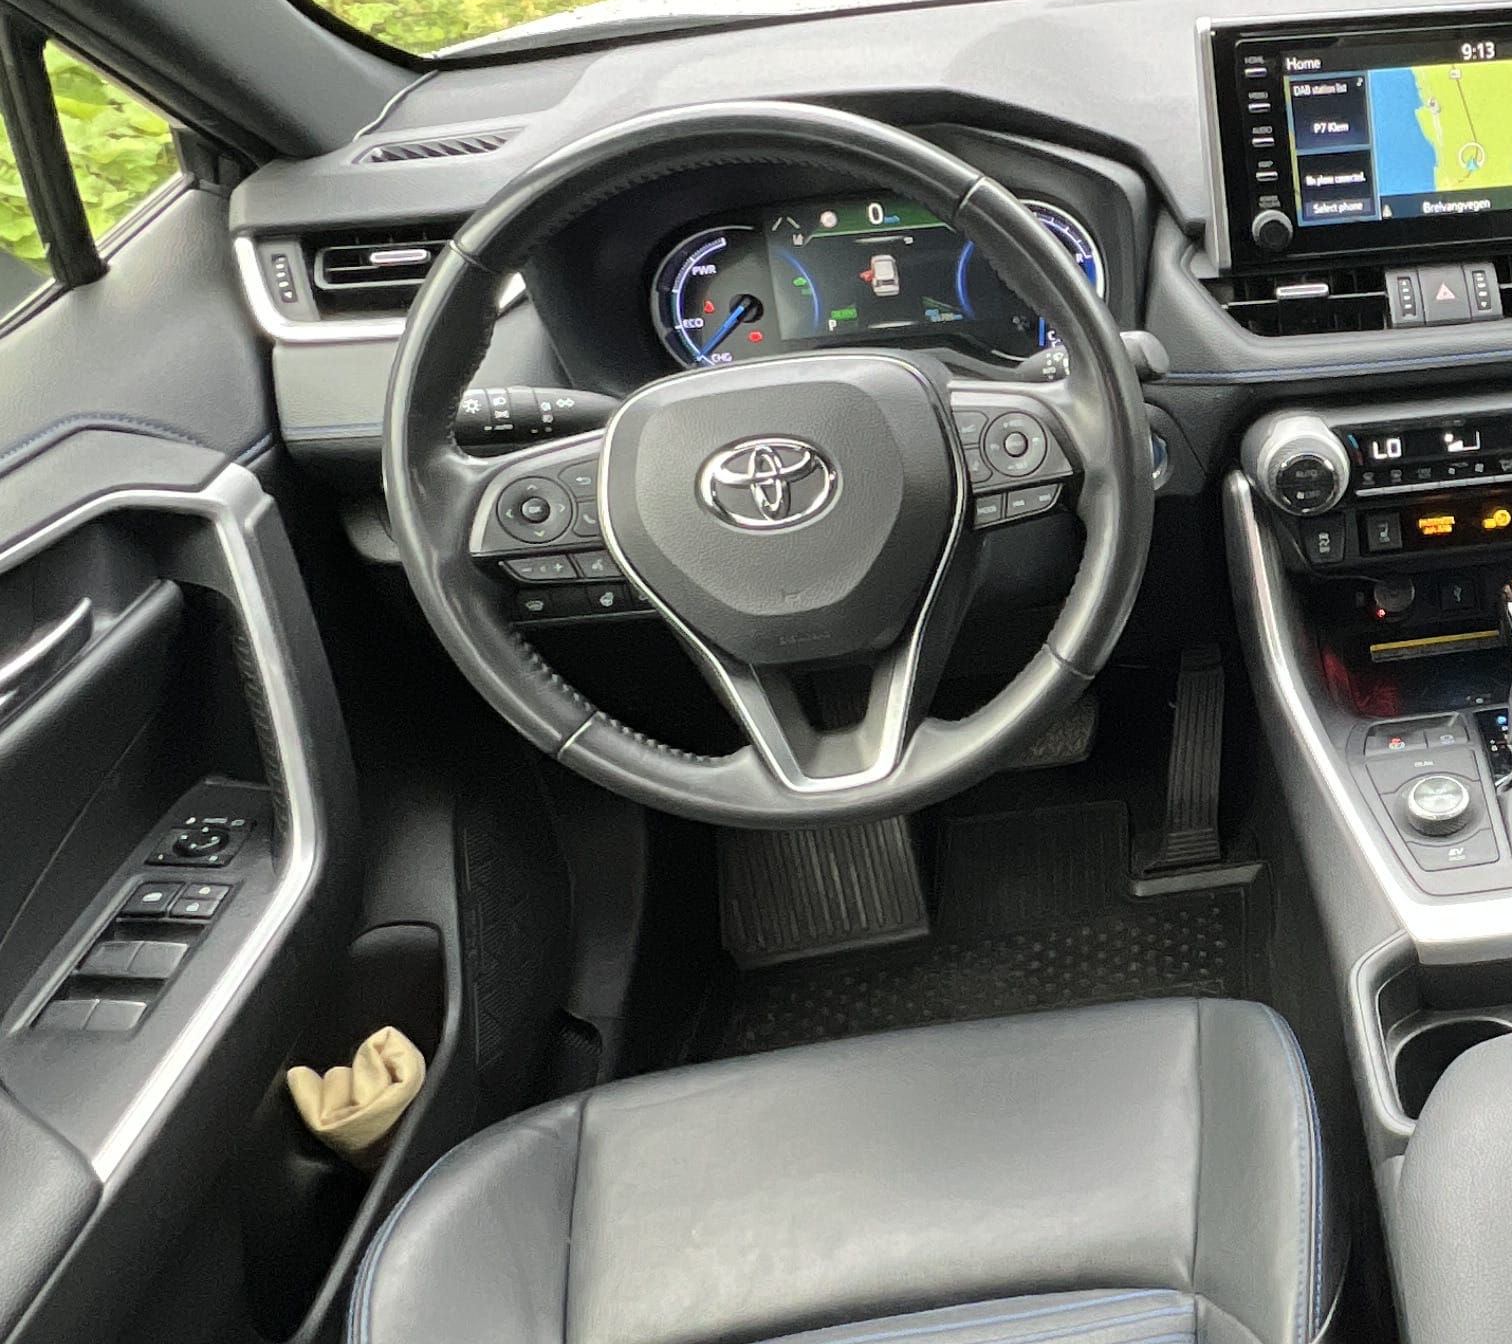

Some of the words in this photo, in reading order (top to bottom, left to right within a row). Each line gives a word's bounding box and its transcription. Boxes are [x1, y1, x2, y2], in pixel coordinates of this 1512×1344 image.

[1461, 42, 1495, 60] 9:13
[1286, 57, 1321, 70] Home
[868, 202, 884, 226] 0
[1313, 203, 1338, 214] Select
[1338, 201, 1363, 214] phone
[691, 264, 717, 276] PWR
[682, 318, 704, 329] ECO
[828, 319, 838, 332] P
[710, 352, 732, 364] CHG
[1372, 437, 1402, 460] LO
